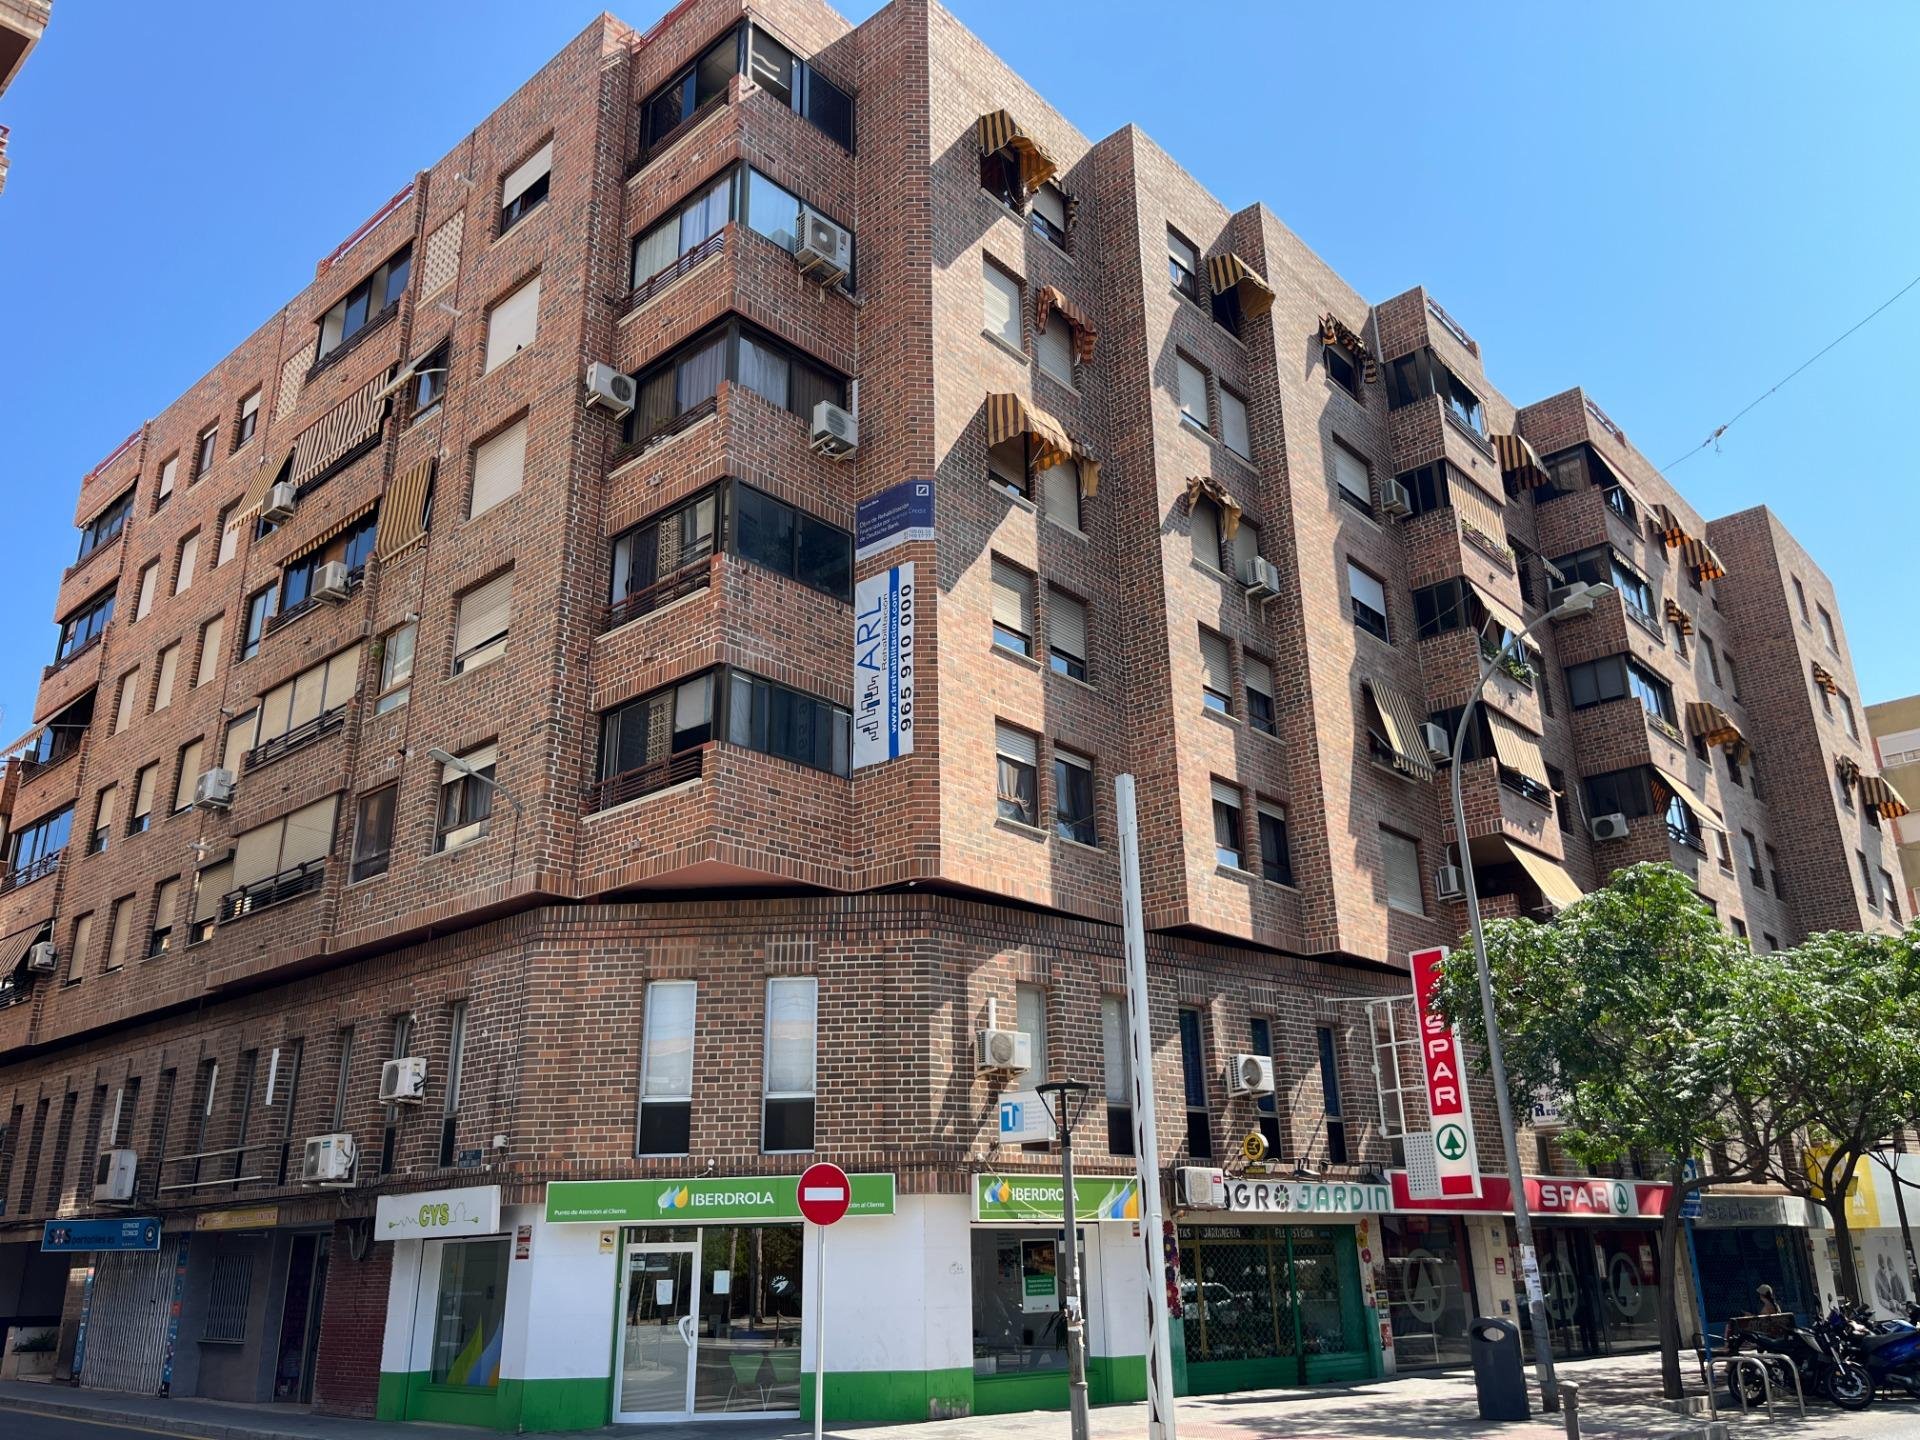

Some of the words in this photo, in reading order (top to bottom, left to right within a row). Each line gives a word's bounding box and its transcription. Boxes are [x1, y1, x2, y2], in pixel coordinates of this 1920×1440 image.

[900, 584, 911, 627] 000
[857, 597, 881, 671] ARL
[889, 591, 898, 734] www.arlrehabilitacion.com
[900, 635, 911, 678] 910
[900, 686, 911, 732] 965
[1425, 1013, 1457, 1107] SPAR
[418, 1203, 449, 1227] CYS
[579, 1208, 602, 1216] Atención
[691, 1191, 775, 1207] IBERDROLA
[1012, 1187, 1080, 1202] IBERDROA
[1541, 1184, 1609, 1209] SPAR
